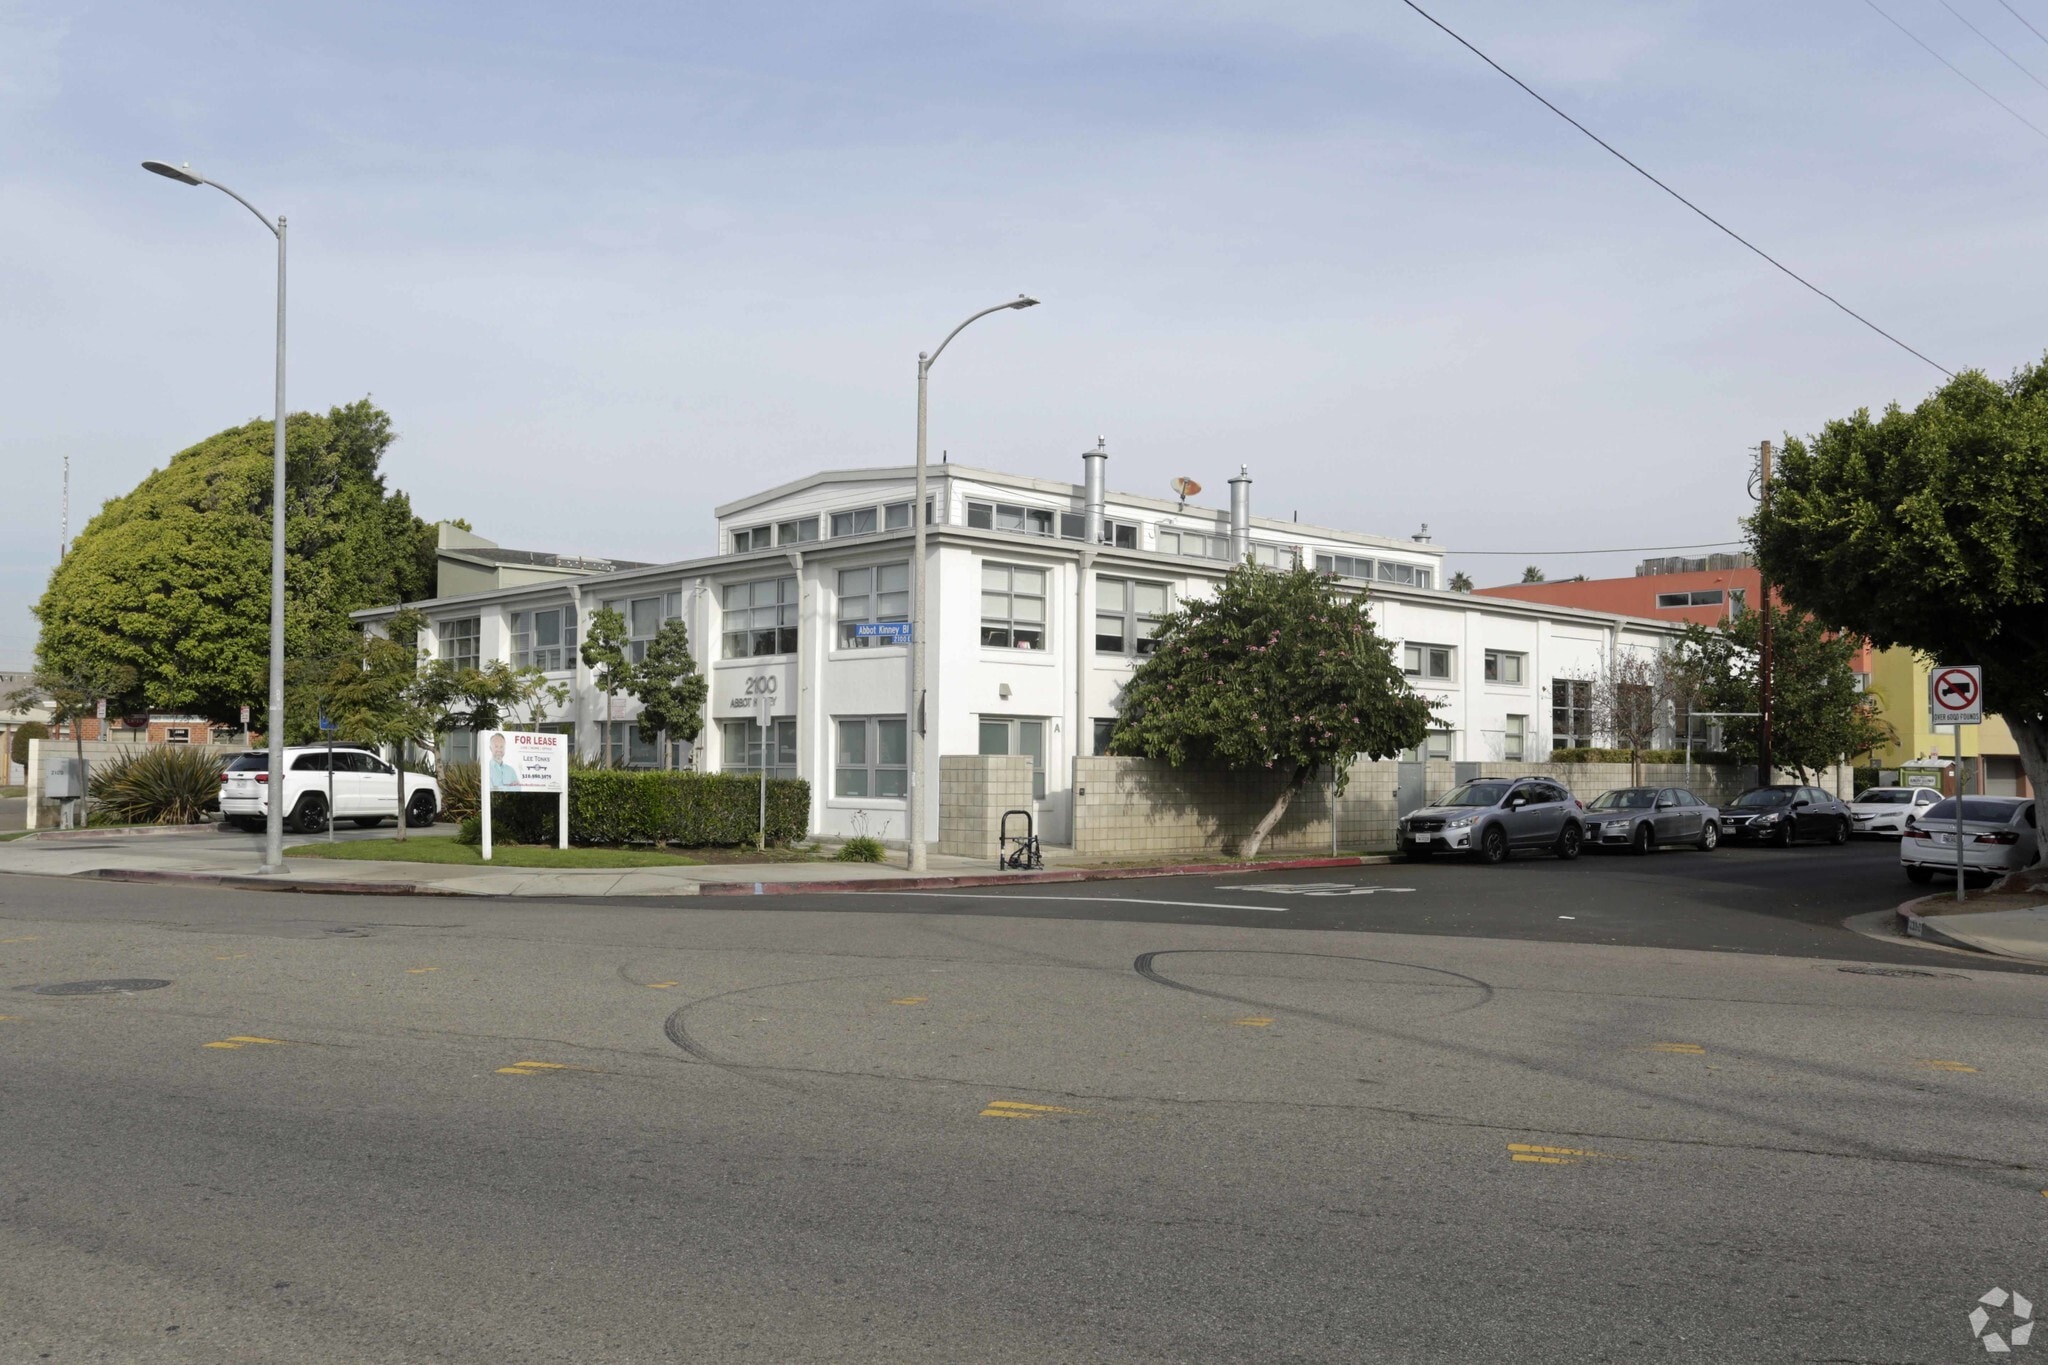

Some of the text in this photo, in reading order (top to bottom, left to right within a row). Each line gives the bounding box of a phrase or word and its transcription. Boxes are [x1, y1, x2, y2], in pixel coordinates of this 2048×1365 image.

[858, 624, 910, 637] Abbot Kinney Bl
[745, 675, 777, 695] 2100
[730, 697, 752, 708] ABBOT
[1934, 713, 1946, 721] OVER
[1960, 712, 1979, 720] POUNDS
[514, 735, 557, 746] FOR LEASE
